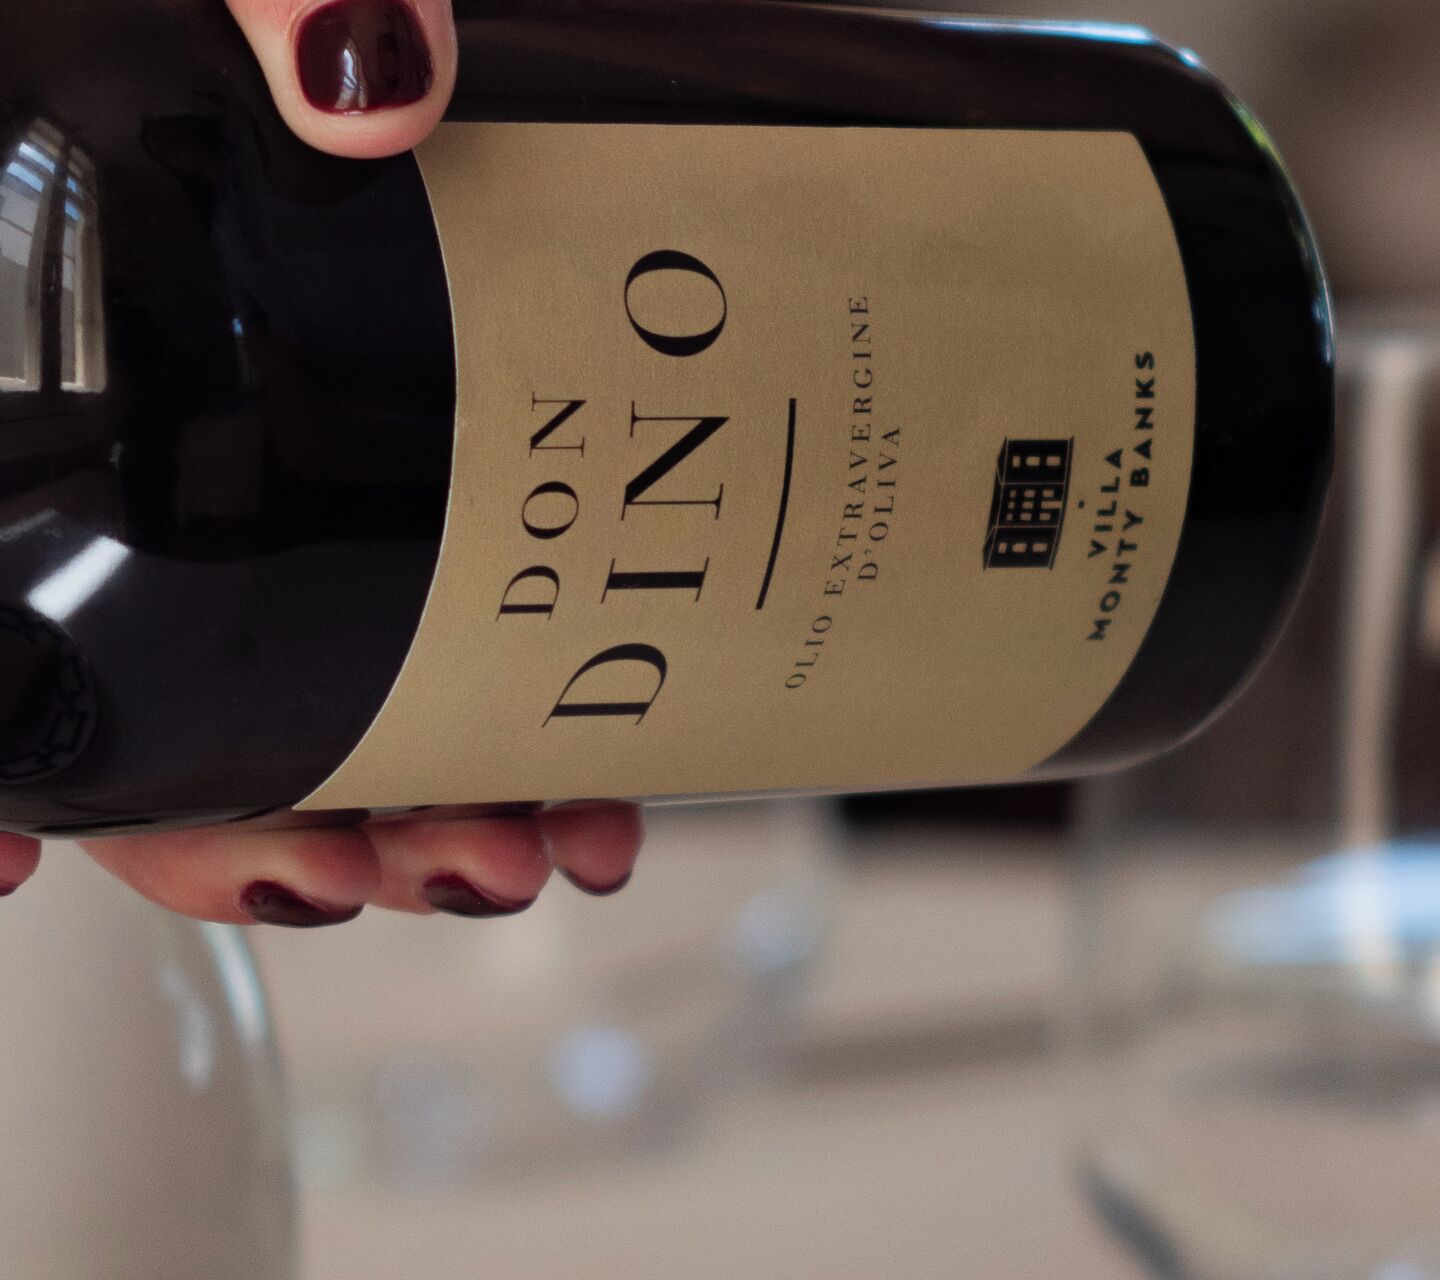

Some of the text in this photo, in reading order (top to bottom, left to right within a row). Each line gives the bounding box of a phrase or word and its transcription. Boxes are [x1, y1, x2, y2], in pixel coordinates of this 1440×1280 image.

[495, 390, 587, 621] DON
[541, 248, 730, 728] DINO
[784, 295, 873, 690] OLIO EXTRAVERGINE
[857, 425, 901, 583] D'OLIVA
[1086, 350, 1155, 641] MONTY BANKS
[1087, 447, 1125, 559] VILLA
